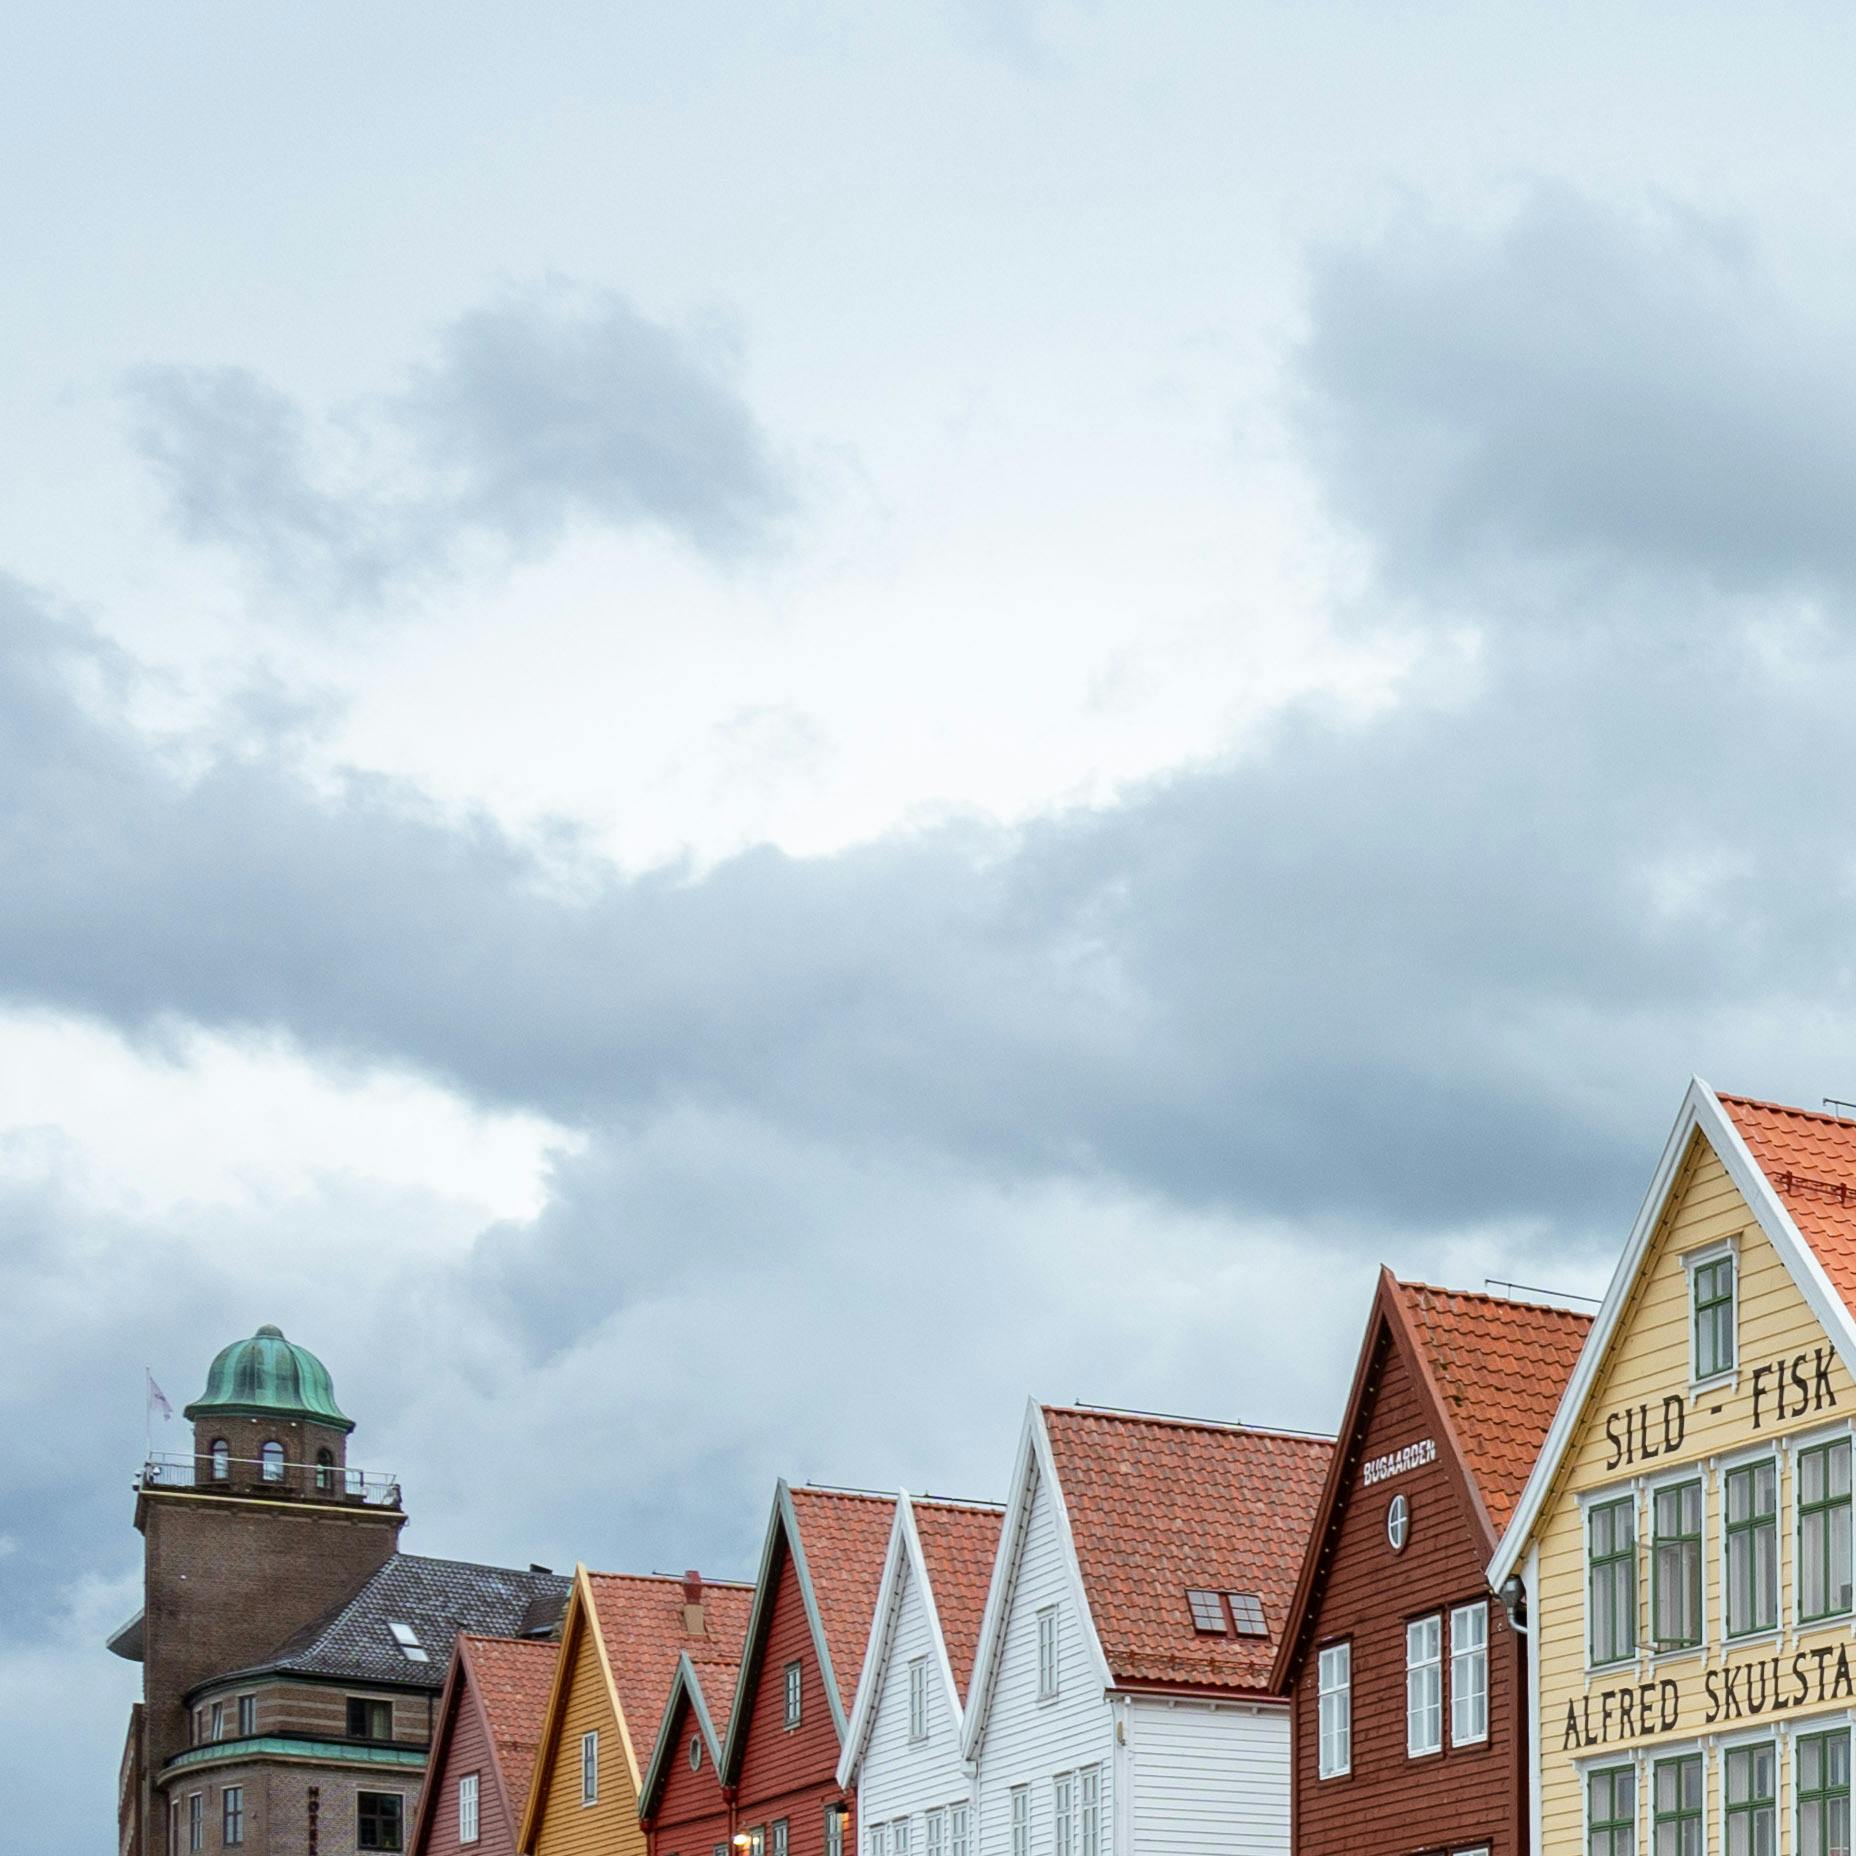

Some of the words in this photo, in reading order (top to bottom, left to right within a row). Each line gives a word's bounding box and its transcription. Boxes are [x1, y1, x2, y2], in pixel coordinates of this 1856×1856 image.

[1605, 1394, 1686, 1470] SILD
[1751, 1347, 1838, 1430] FISK
[1363, 1439, 1437, 1487] BUGAARDEN
[1563, 1678, 1680, 1750] ALFRED
